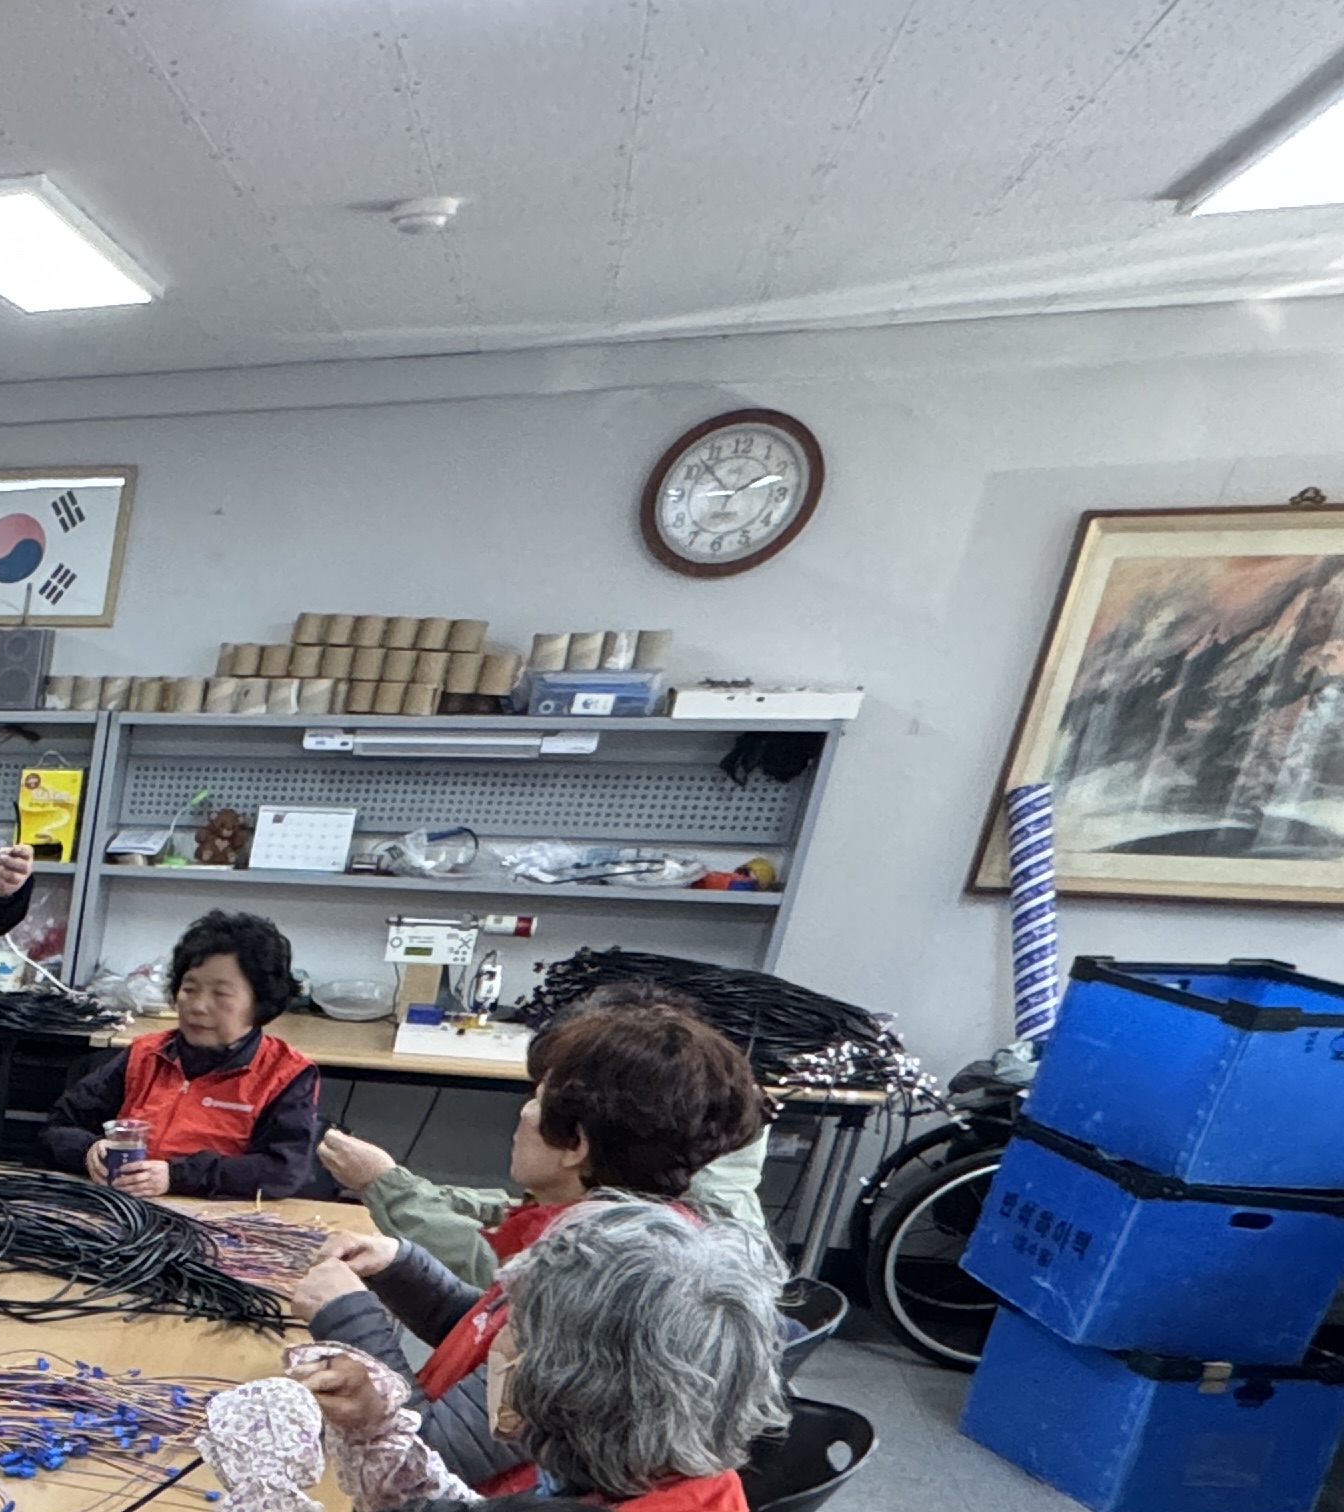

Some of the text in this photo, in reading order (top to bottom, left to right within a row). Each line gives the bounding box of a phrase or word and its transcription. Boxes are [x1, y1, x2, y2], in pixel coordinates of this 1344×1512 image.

[707, 443, 722, 461] 11
[731, 437, 754, 454] 12
[763, 444, 772, 461] 1
[684, 464, 700, 480] 10
[777, 461, 788, 474] 2
[774, 486, 788, 503] 3
[673, 511, 685, 528] 8
[761, 510, 773, 527] 4
[688, 531, 701, 546] 7
[710, 535, 724, 551] 6
[737, 530, 751, 547] 5
